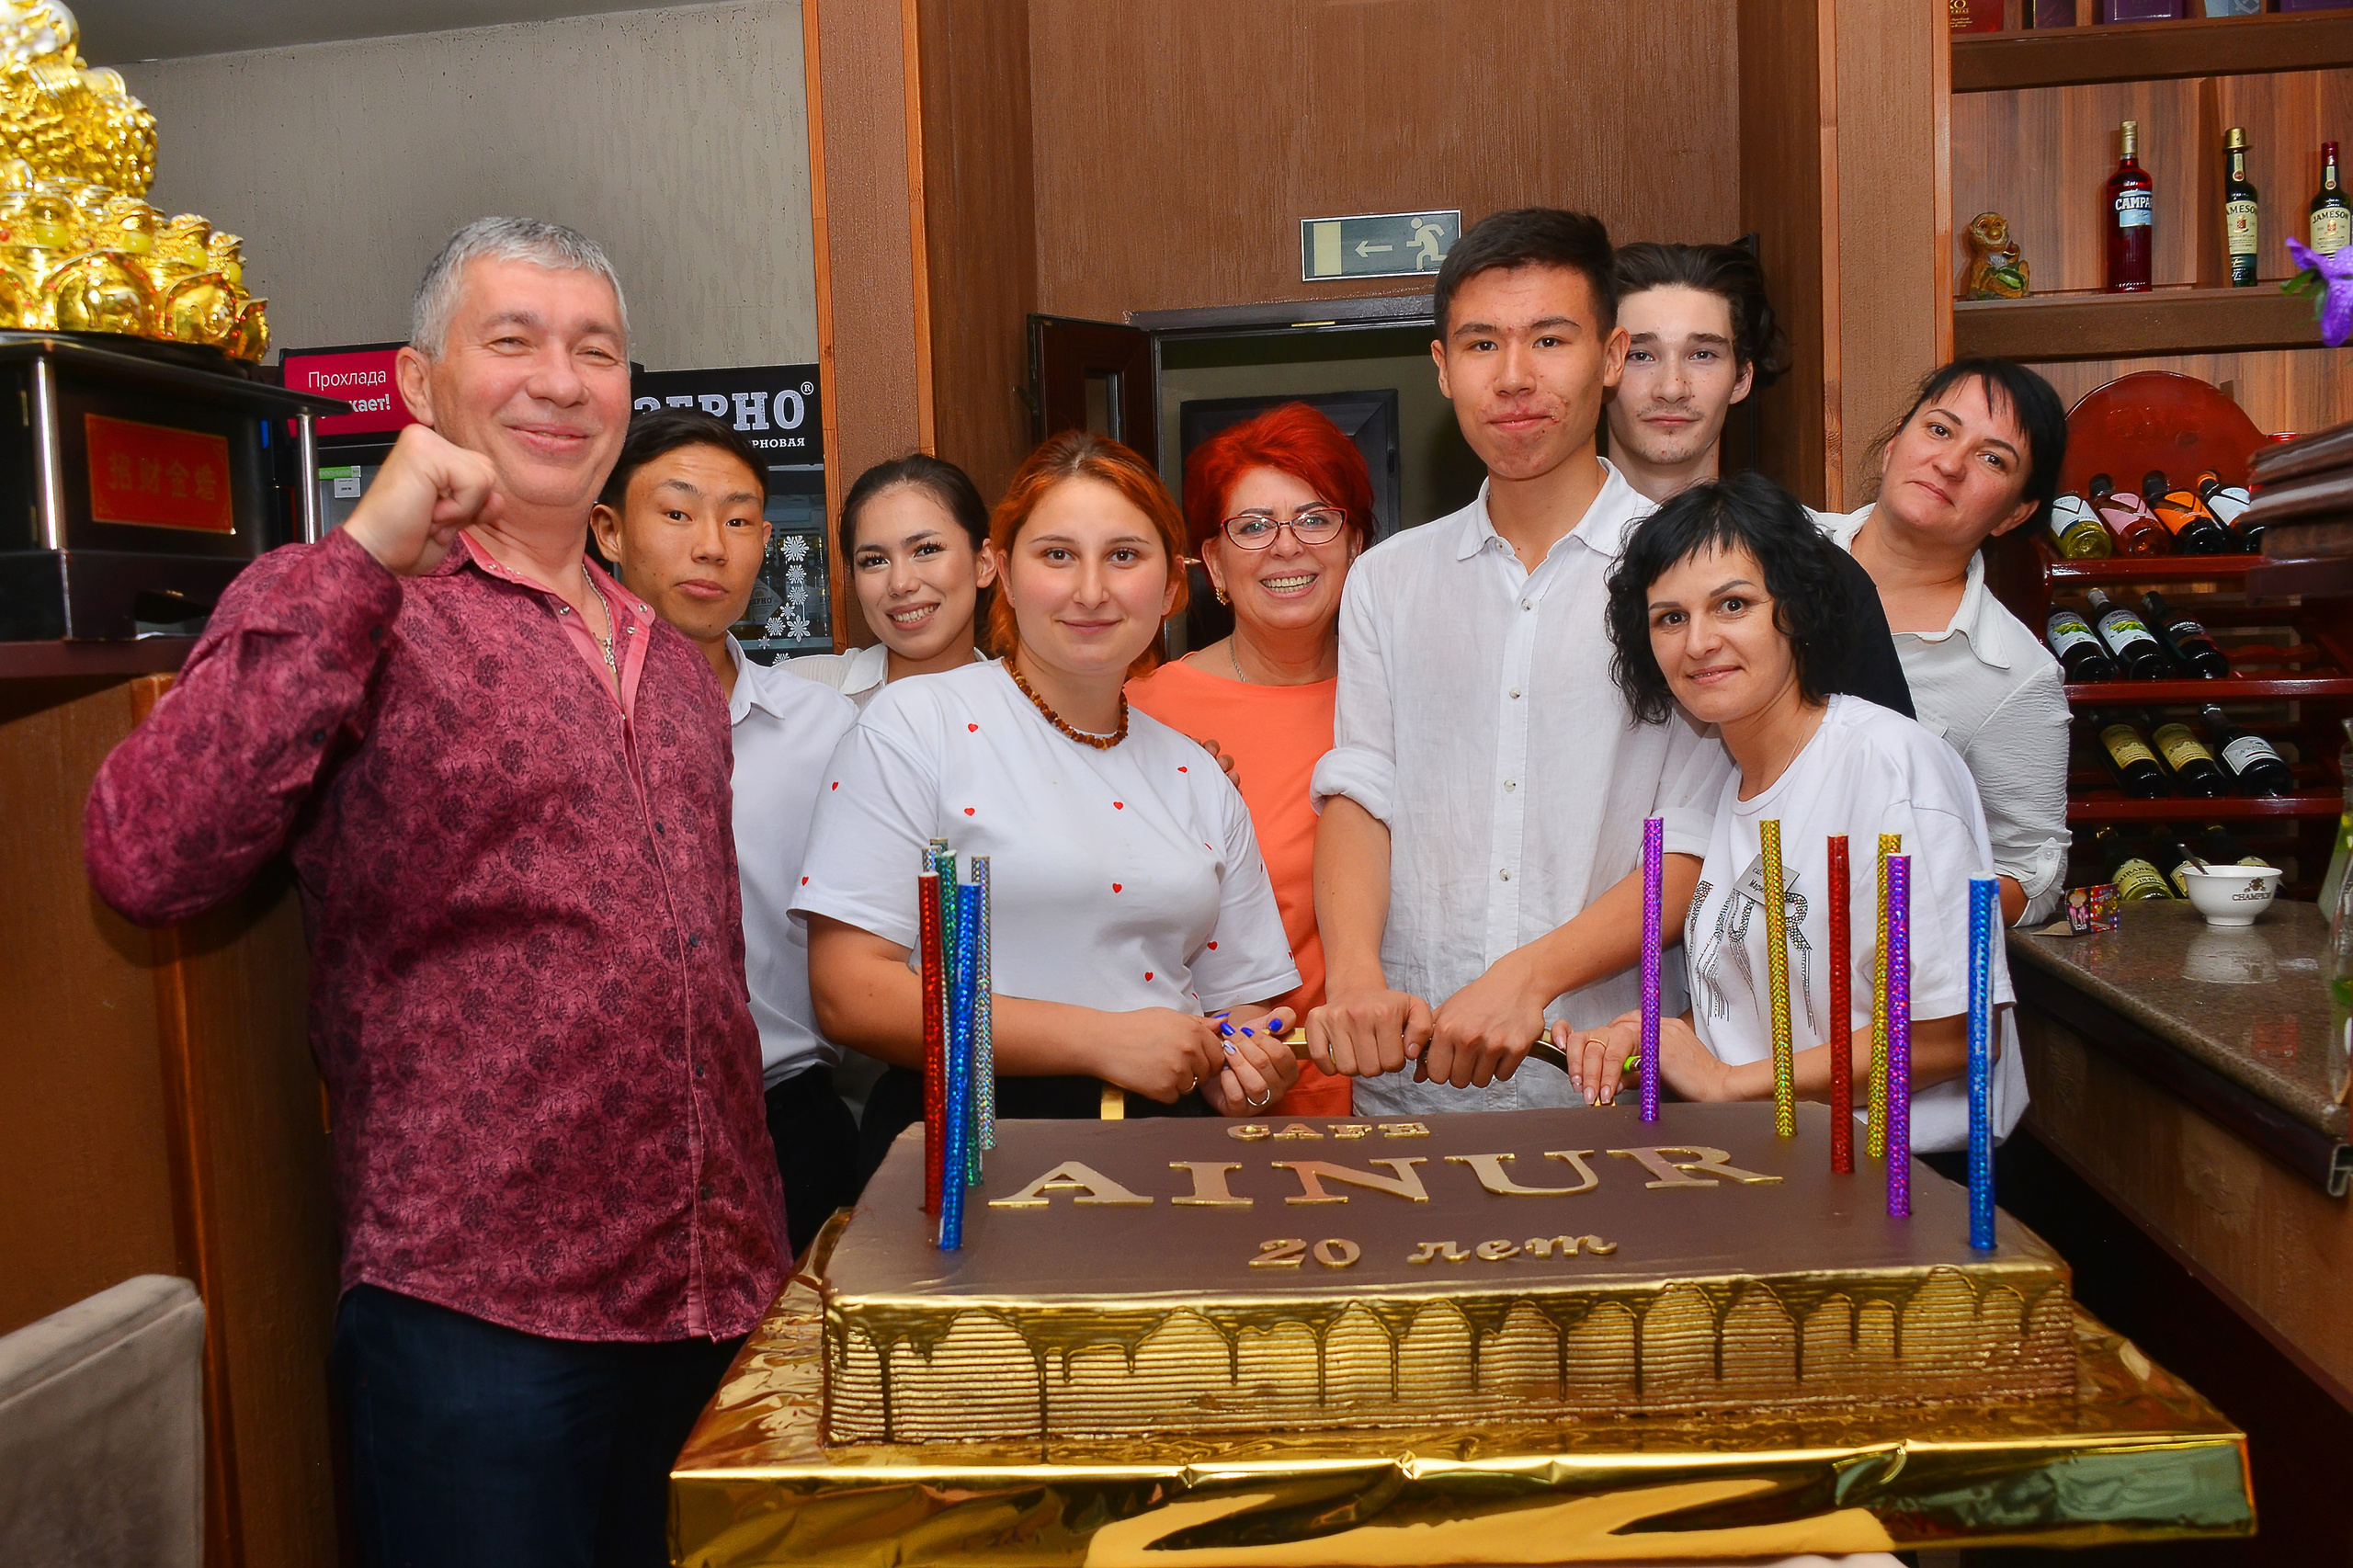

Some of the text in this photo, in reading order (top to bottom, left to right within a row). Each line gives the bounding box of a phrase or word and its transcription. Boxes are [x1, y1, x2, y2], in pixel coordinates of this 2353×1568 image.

[2115, 197, 2152, 210] CAMPA
[2313, 210, 2348, 224] JAMESON
[308, 370, 387, 391] Прохлада
[752, 437, 805, 449] РНОВАЯ
[1227, 1122, 1430, 1141] CAFE
[988, 1145, 1784, 1207] AINUR
[1248, 1234, 1618, 1267] 20 лет
